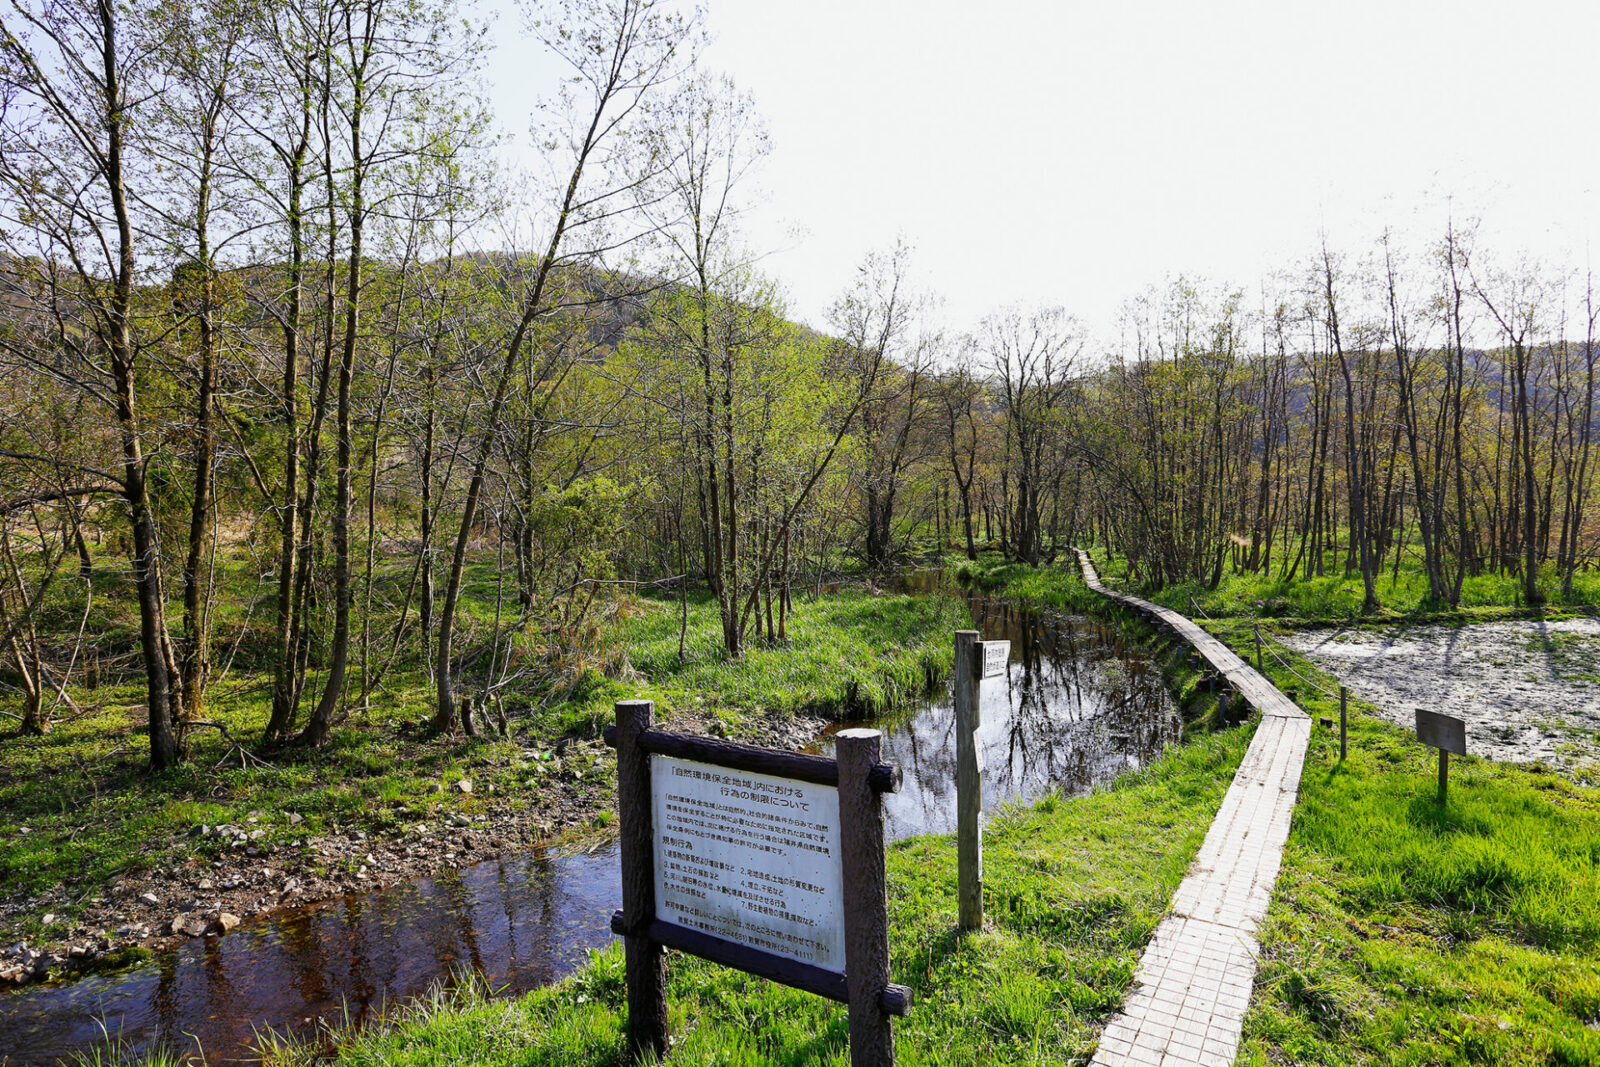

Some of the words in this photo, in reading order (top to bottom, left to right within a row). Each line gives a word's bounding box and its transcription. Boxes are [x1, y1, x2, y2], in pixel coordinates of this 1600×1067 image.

[671, 765, 803, 799] 「自然環境保全地域」内における
[719, 786, 810, 812] 行為の制限について
[662, 834, 693, 851] 規制行為
